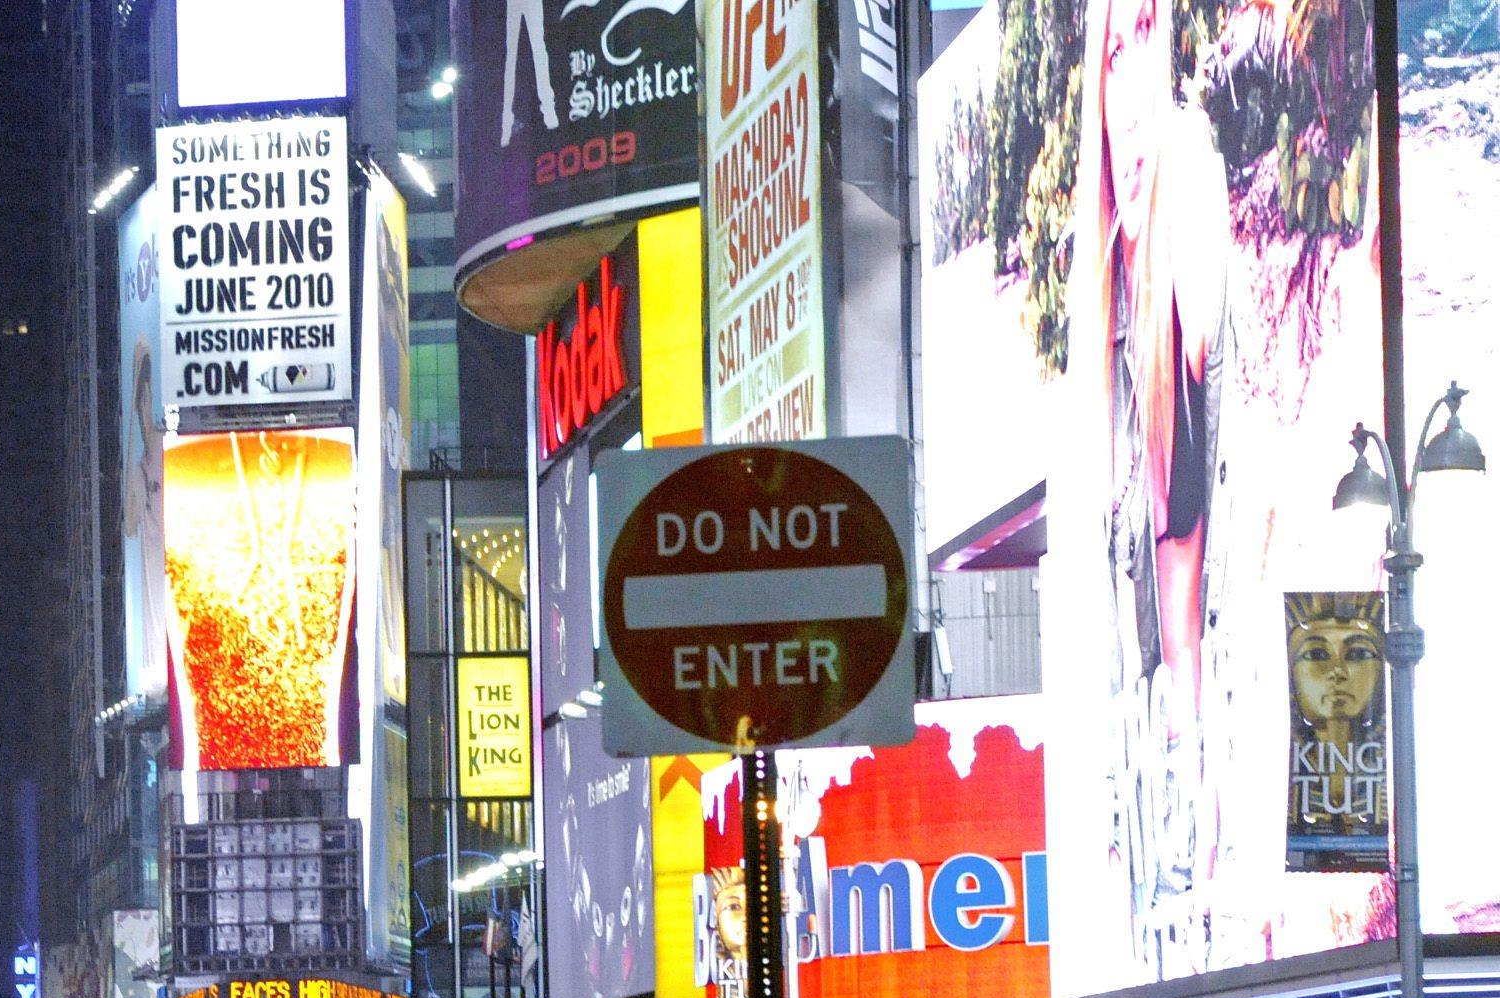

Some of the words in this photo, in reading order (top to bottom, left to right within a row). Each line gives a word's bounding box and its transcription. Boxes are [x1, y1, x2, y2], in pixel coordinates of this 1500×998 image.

[569, 49, 596, 80] By
[172, 129, 331, 165] SOMETHING
[536, 131, 636, 186] 2009
[714, 86, 796, 229] MACHIDA
[173, 171, 285, 213] FRESH
[298, 168, 331, 206] IS
[172, 216, 333, 270] COMING
[728, 158, 797, 289] SHOGUN
[175, 276, 256, 315] JUNE
[266, 272, 335, 310] 2010
[718, 315, 745, 387] SAT.
[749, 280, 781, 361] MAY
[786, 271, 796, 331] 8
[176, 360, 249, 398] .COM
[536, 255, 625, 459] Kodak
[766, 349, 783, 393] ON
[656, 511, 725, 557] DO
[749, 503, 850, 551] NOT
[674, 640, 840, 690] ENTER
[474, 684, 513, 702] THE
[467, 710, 520, 740] LION
[468, 746, 523, 777] KING
[1293, 741, 1384, 774] KING
[1291, 775, 1386, 815] TUT
